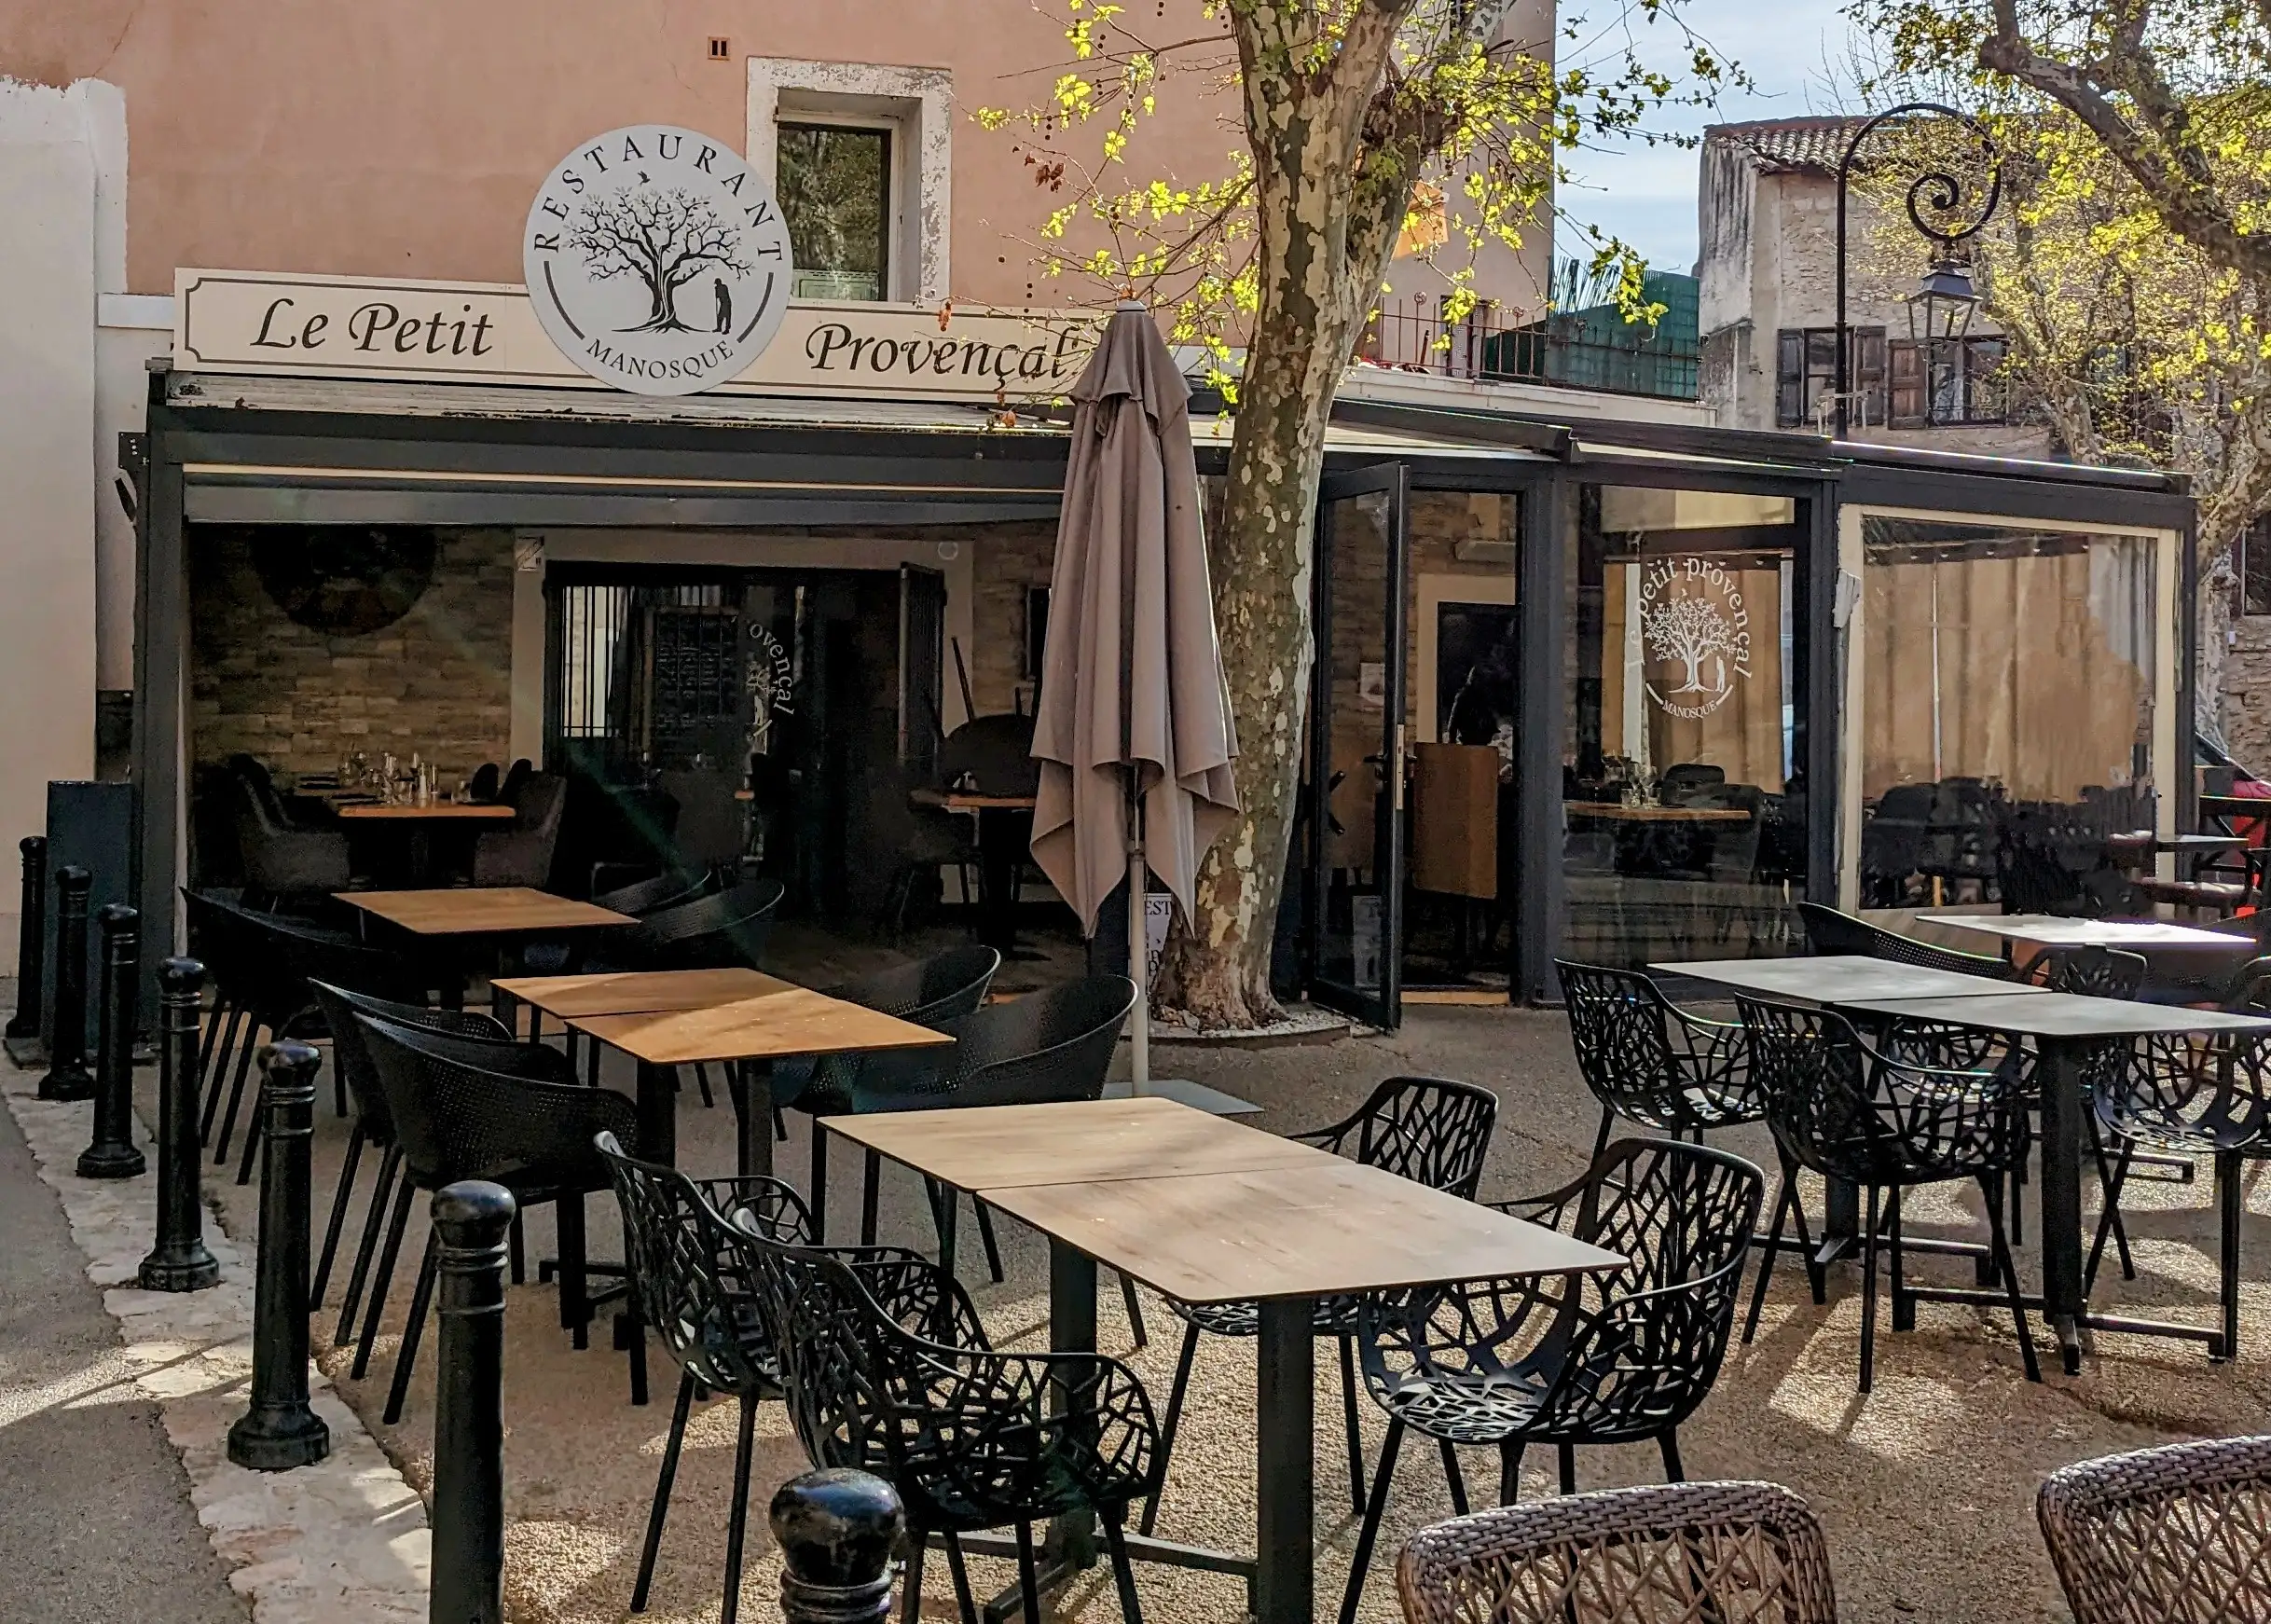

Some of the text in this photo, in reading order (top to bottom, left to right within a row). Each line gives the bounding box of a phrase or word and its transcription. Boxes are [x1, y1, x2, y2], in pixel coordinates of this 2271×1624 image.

[533, 133, 782, 261] RESTAURANT
[251, 298, 1081, 391] Le Petit Provençal
[586, 338, 734, 378] MANOSQUE
[1636, 557, 1678, 620] petit
[1684, 557, 1753, 679] provençal
[749, 623, 794, 715] ovençal
[1662, 700, 1717, 718] MANOSQUE
